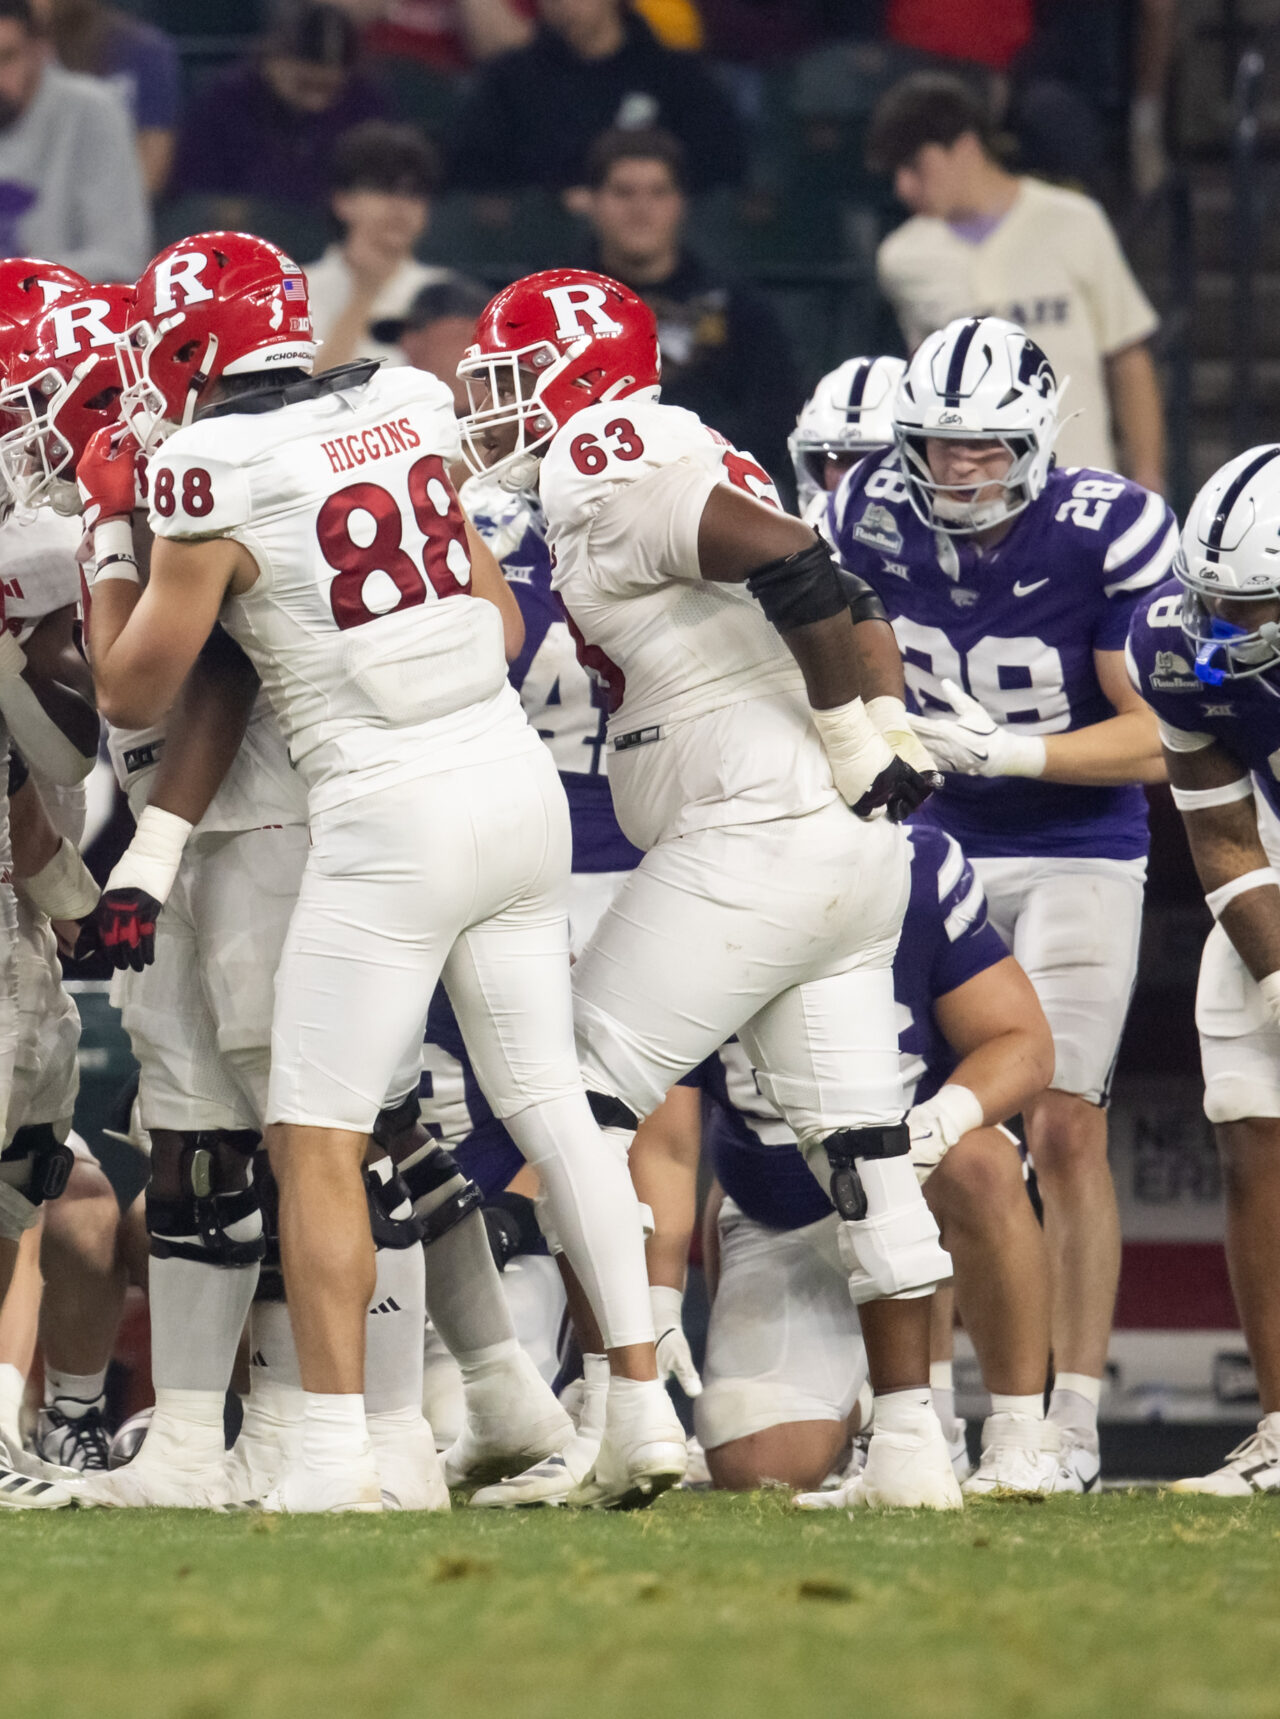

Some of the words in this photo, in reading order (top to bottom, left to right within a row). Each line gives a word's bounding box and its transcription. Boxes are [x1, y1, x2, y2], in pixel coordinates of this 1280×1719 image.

[153, 252, 214, 316] R
[543, 284, 623, 340] R
[51, 299, 125, 358] R
[320, 417, 421, 474] HIGGINS
[570, 417, 645, 476] 63
[154, 467, 215, 518] 88
[1055, 480, 1125, 531] 28
[316, 454, 473, 631] 88
